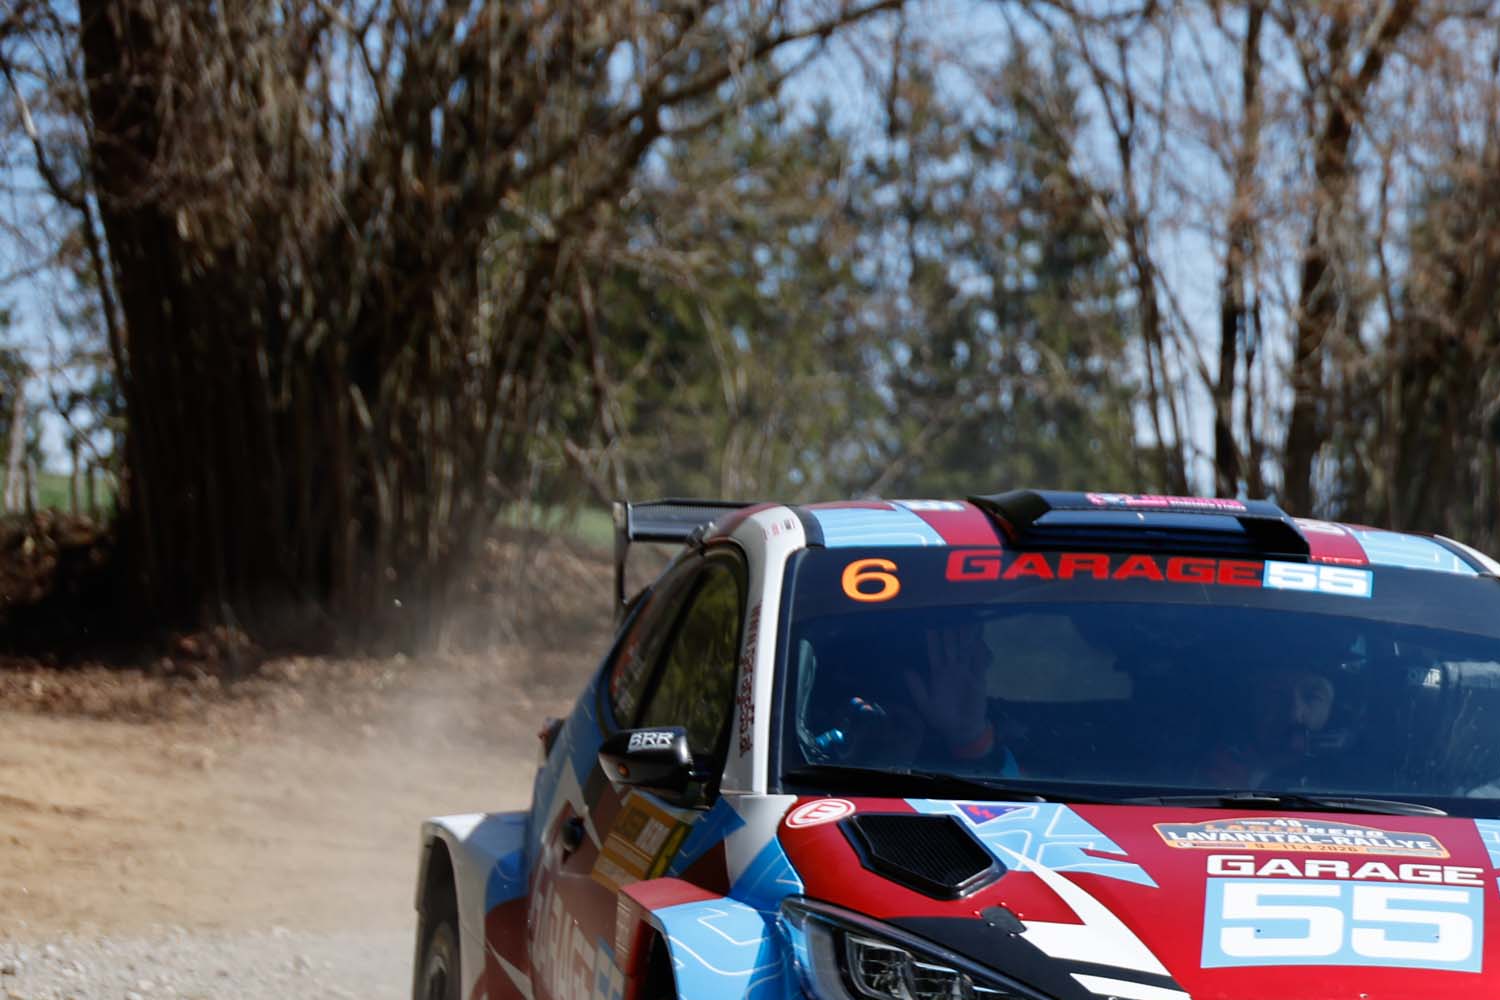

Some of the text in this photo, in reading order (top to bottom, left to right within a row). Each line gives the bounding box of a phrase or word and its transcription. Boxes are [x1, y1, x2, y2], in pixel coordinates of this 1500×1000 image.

[841, 558, 900, 602] 6
[945, 550, 1370, 593] GARAGE 55
[627, 731, 673, 752] BRR
[1168, 831, 1436, 850] LAVANTTAL-RALLYE
[1206, 854, 1484, 885] GARAGE
[1220, 882, 1472, 962] 55
